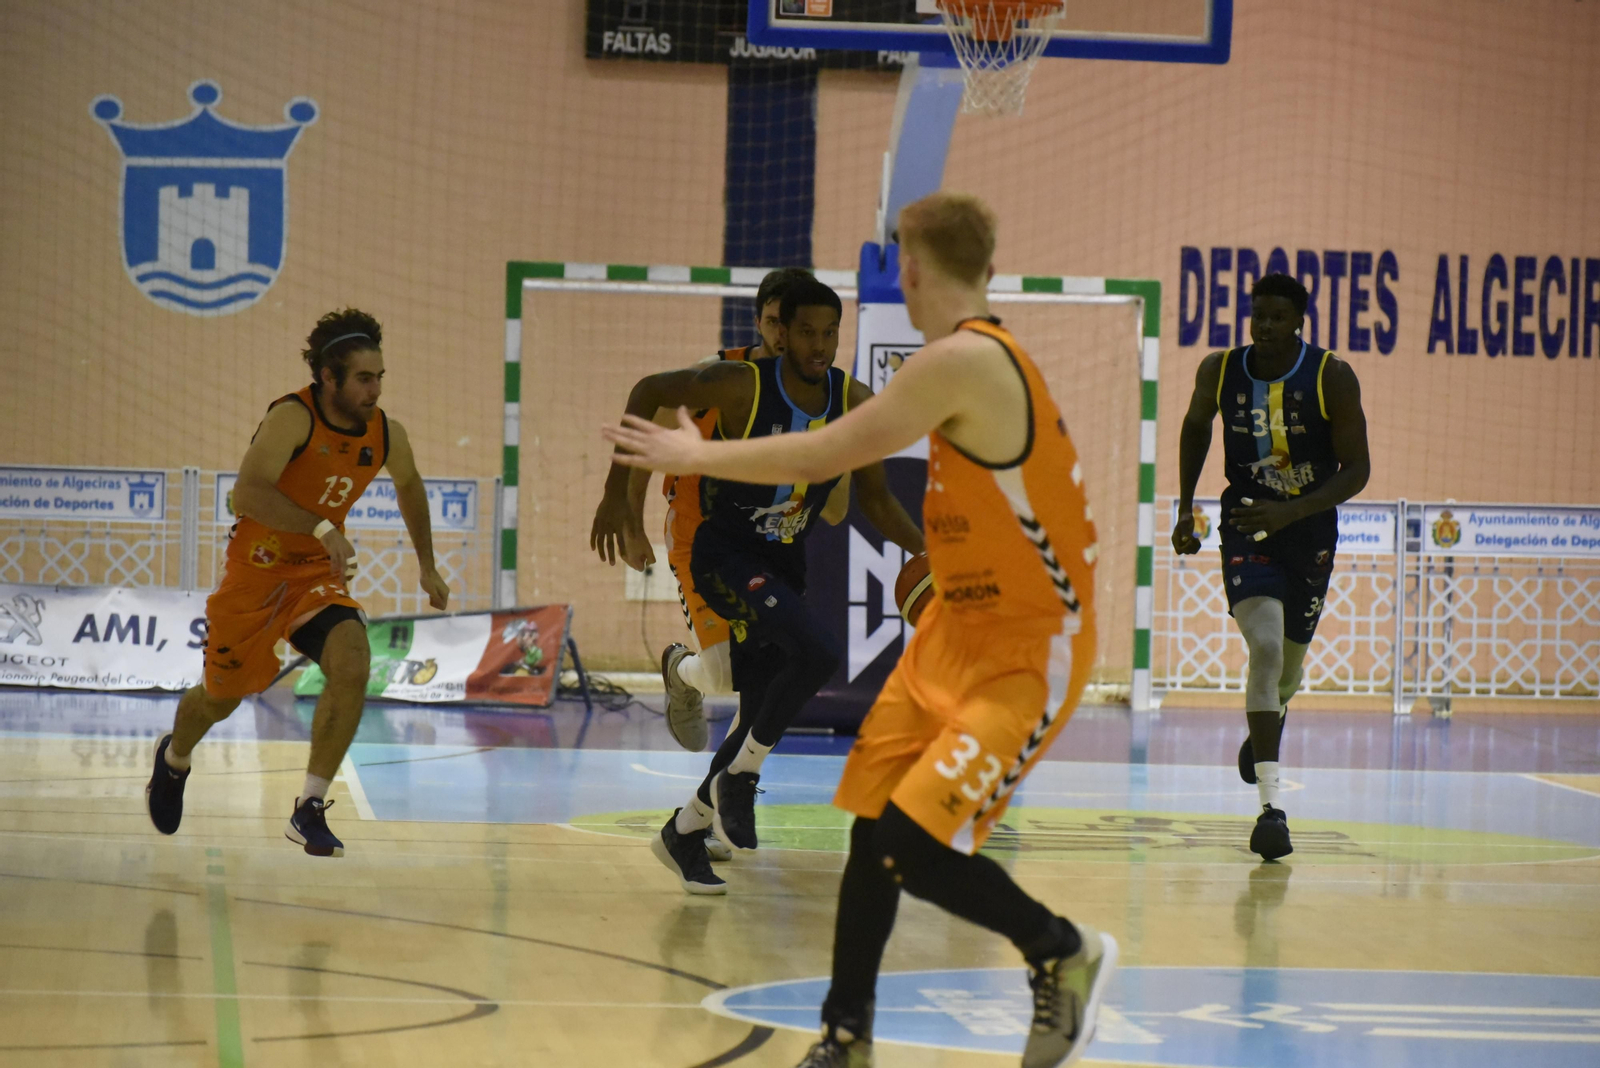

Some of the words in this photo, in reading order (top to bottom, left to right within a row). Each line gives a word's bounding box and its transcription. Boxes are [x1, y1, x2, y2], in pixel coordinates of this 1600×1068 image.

[602, 30, 672, 54] FALTAS
[1250, 408, 1288, 437] 34
[46, 478, 59, 488] de
[62, 475, 121, 492] Algeciras
[317, 475, 354, 508] 13
[33, 496, 50, 509] de
[54, 497, 114, 511] Deportes
[1338, 509, 1387, 525] lgeciras
[1469, 511, 1560, 527] Ayuntamiento
[1563, 515, 1576, 526] de
[1475, 533, 1548, 548] Delegación
[1551, 535, 1567, 546] de
[72, 612, 168, 652] AMI,
[50, 672, 98, 686] Peugeot
[102, 672, 122, 686] del
[934, 732, 1003, 801] 33
